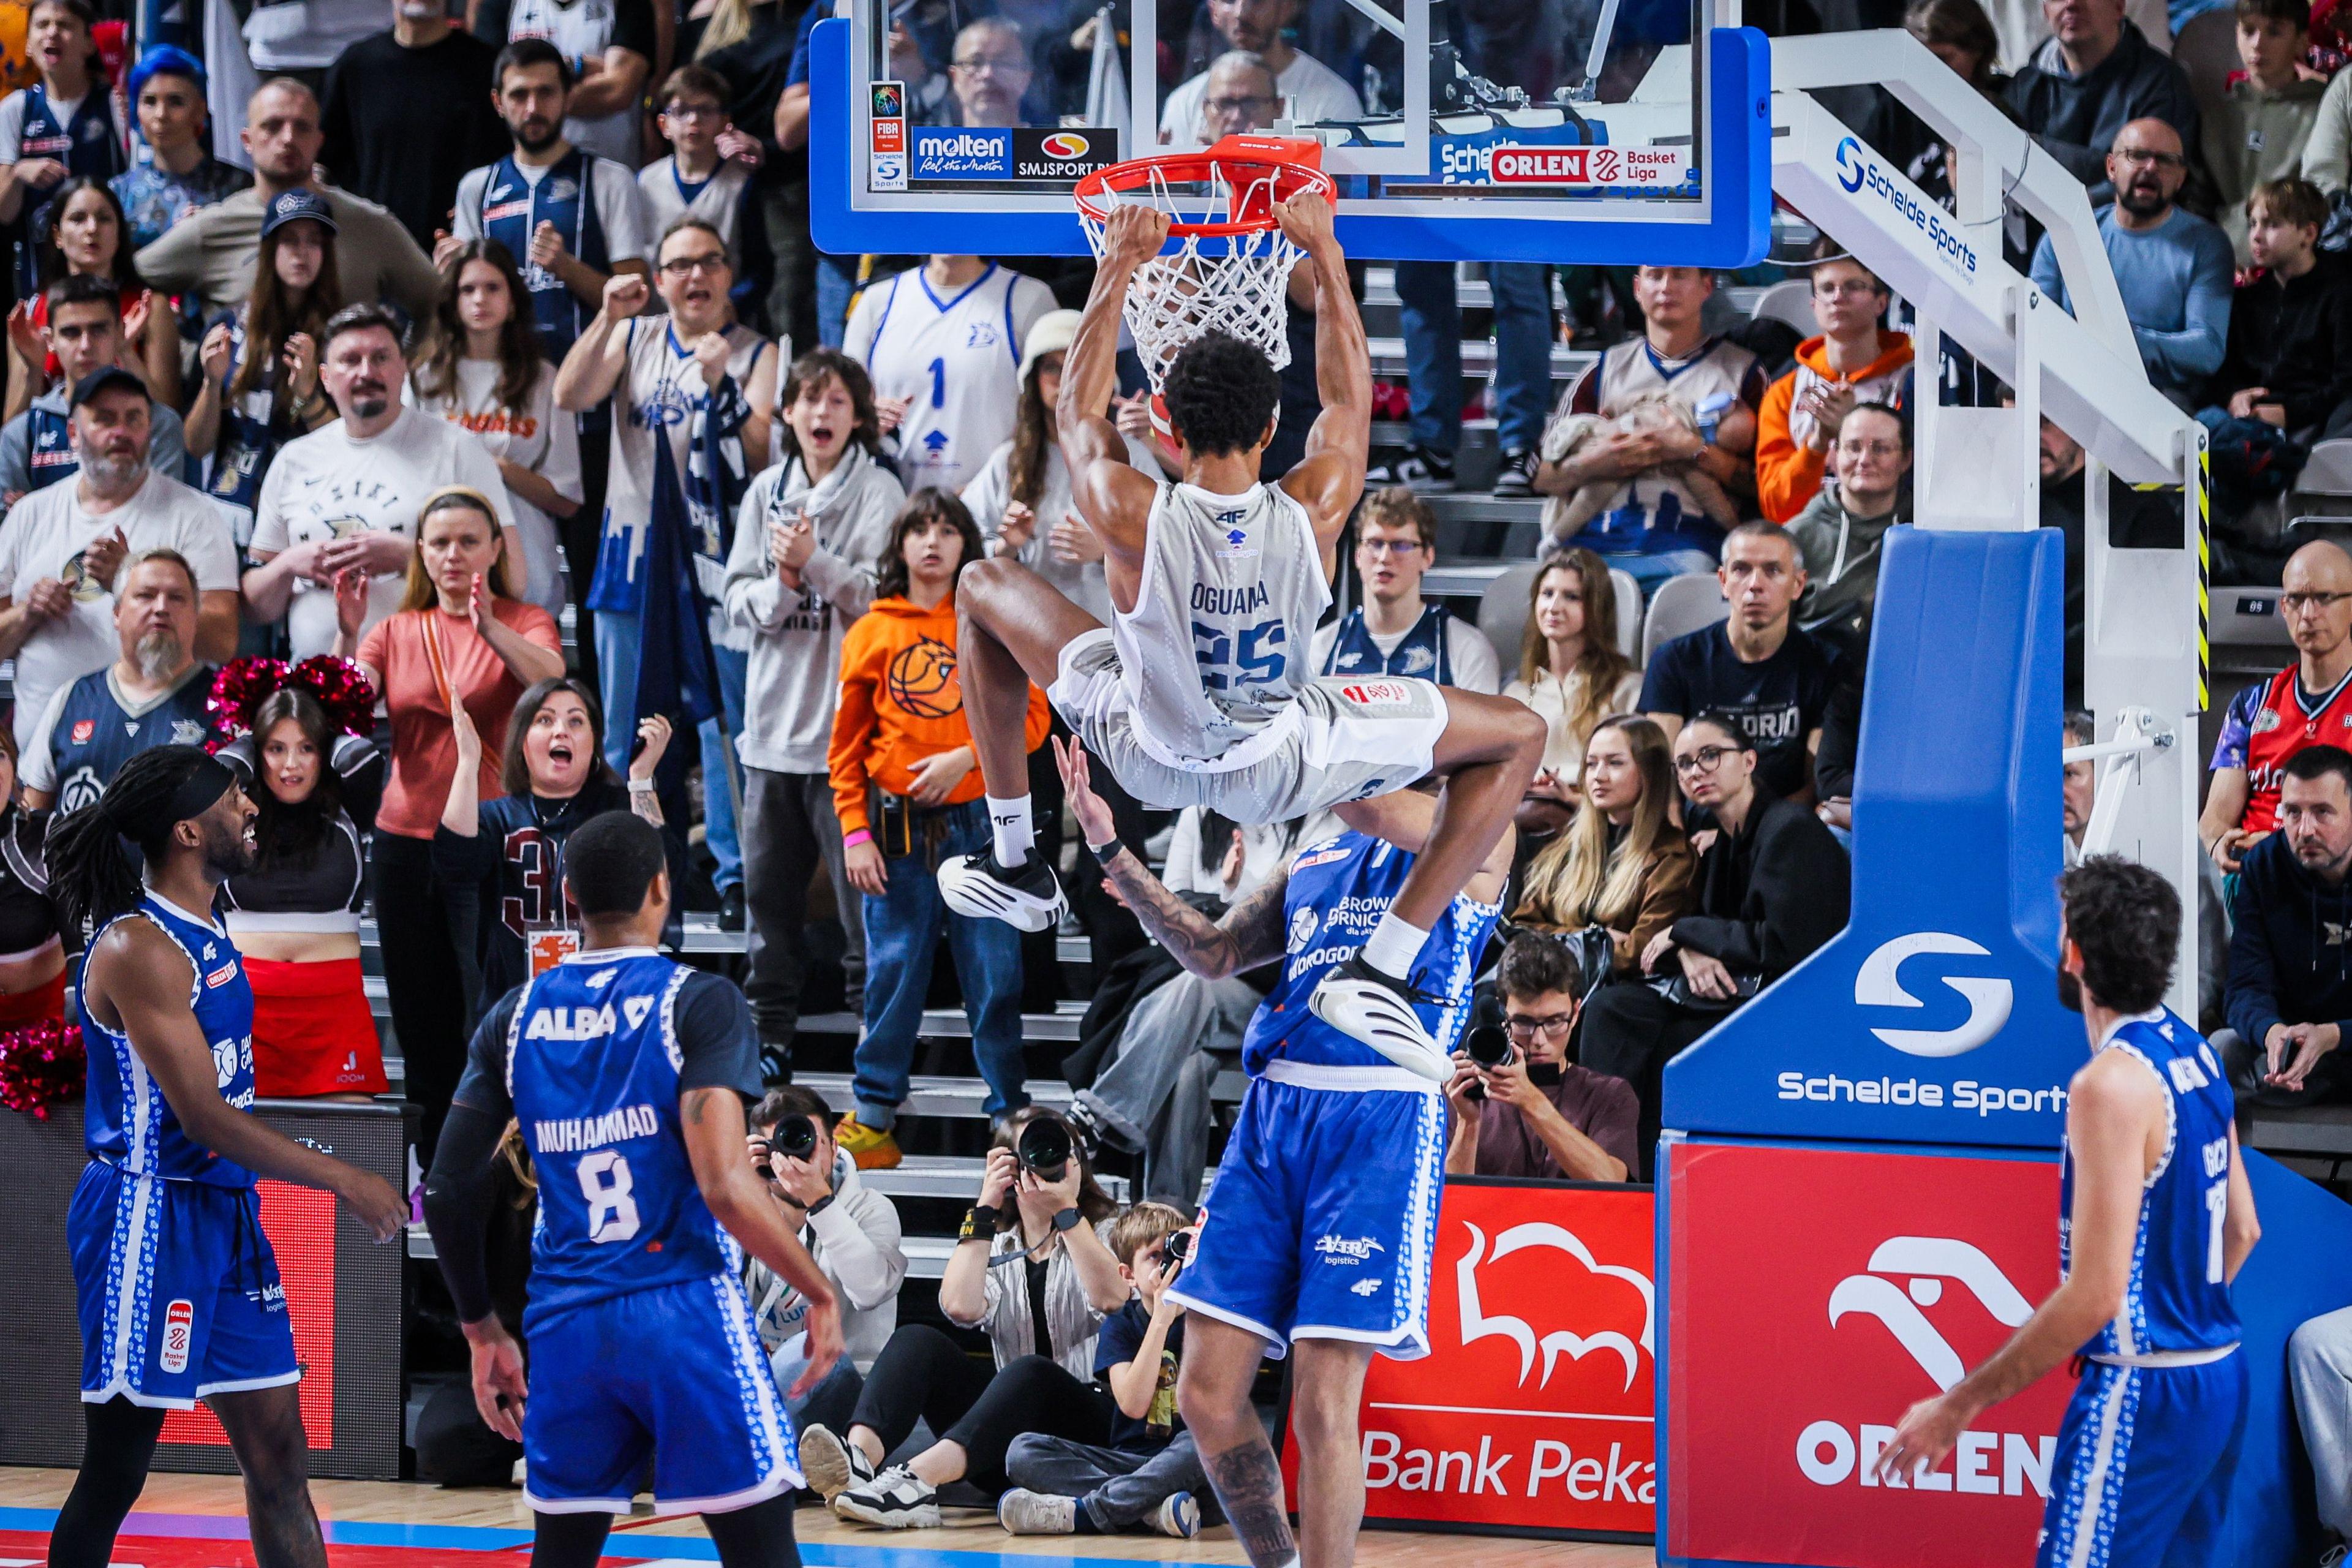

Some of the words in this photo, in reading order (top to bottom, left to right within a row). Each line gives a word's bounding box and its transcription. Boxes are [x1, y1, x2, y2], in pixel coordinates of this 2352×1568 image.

[877, 123, 899, 134] FIBA
[919, 135, 1003, 157] molten
[1498, 154, 1580, 176] ORLEN
[1627, 151, 1676, 164] Basket
[1627, 166, 1657, 181] Liga
[1866, 163, 1926, 230] Schelde
[1928, 216, 1976, 272] Sports
[929, 357, 944, 409] 1
[525, 1001, 617, 1041] ALBA
[1778, 1072, 1943, 1107] Schelde
[1953, 1080, 2070, 1117] Sport
[534, 1104, 659, 1153] MUHAMMAD
[576, 1148, 641, 1245] 8
[1325, 1256, 1360, 1266] logistics
[1351, 1278, 1382, 1296] 4F
[170, 1309, 191, 1318] ORLEN
[165, 1351, 186, 1360] Basket
[168, 1359, 181, 1367] Liga
[1362, 1430, 1513, 1496] Bank
[1796, 1420, 2058, 1499] ORLEN
